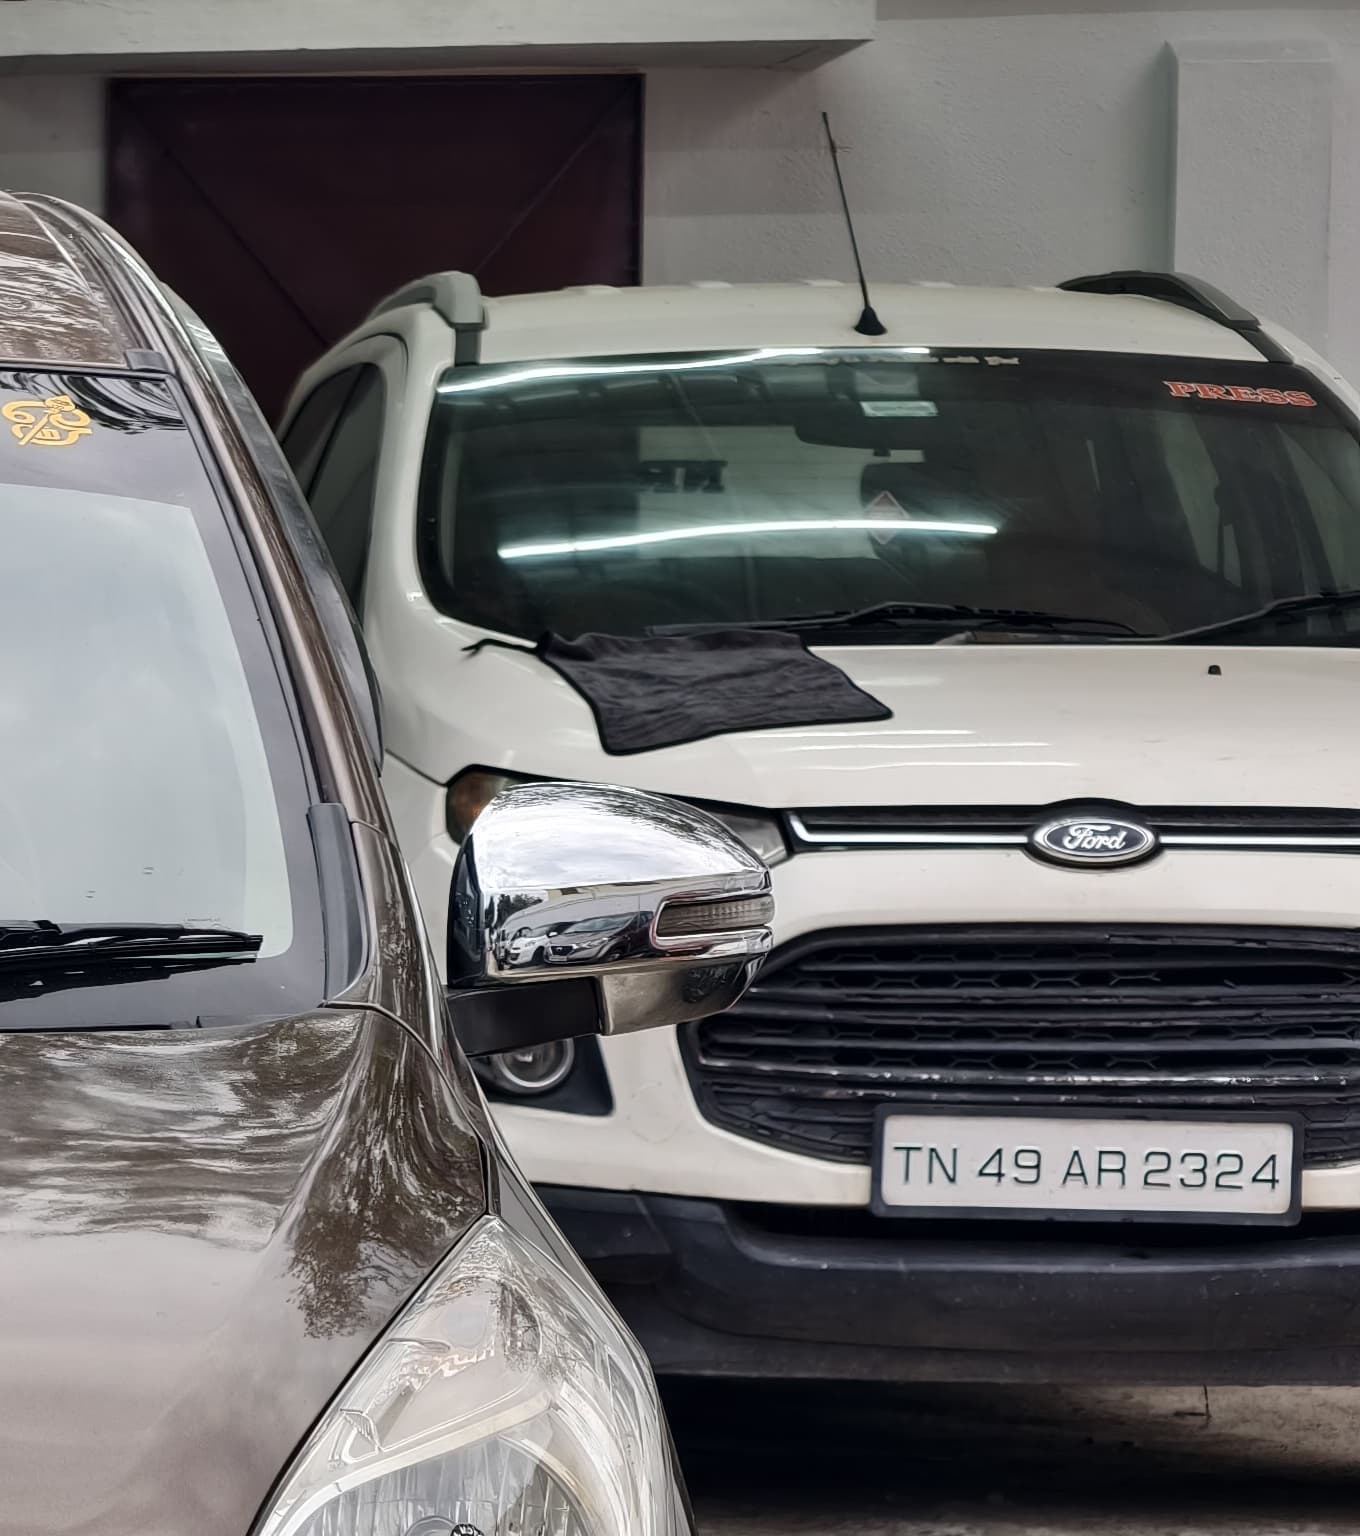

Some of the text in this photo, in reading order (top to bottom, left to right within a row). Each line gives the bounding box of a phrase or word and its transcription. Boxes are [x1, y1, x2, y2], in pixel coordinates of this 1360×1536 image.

[1162, 380, 1318, 407] PRESS
[1062, 822, 1127, 852] Ford
[894, 1146, 1280, 1190] TN 49 AR 2324
